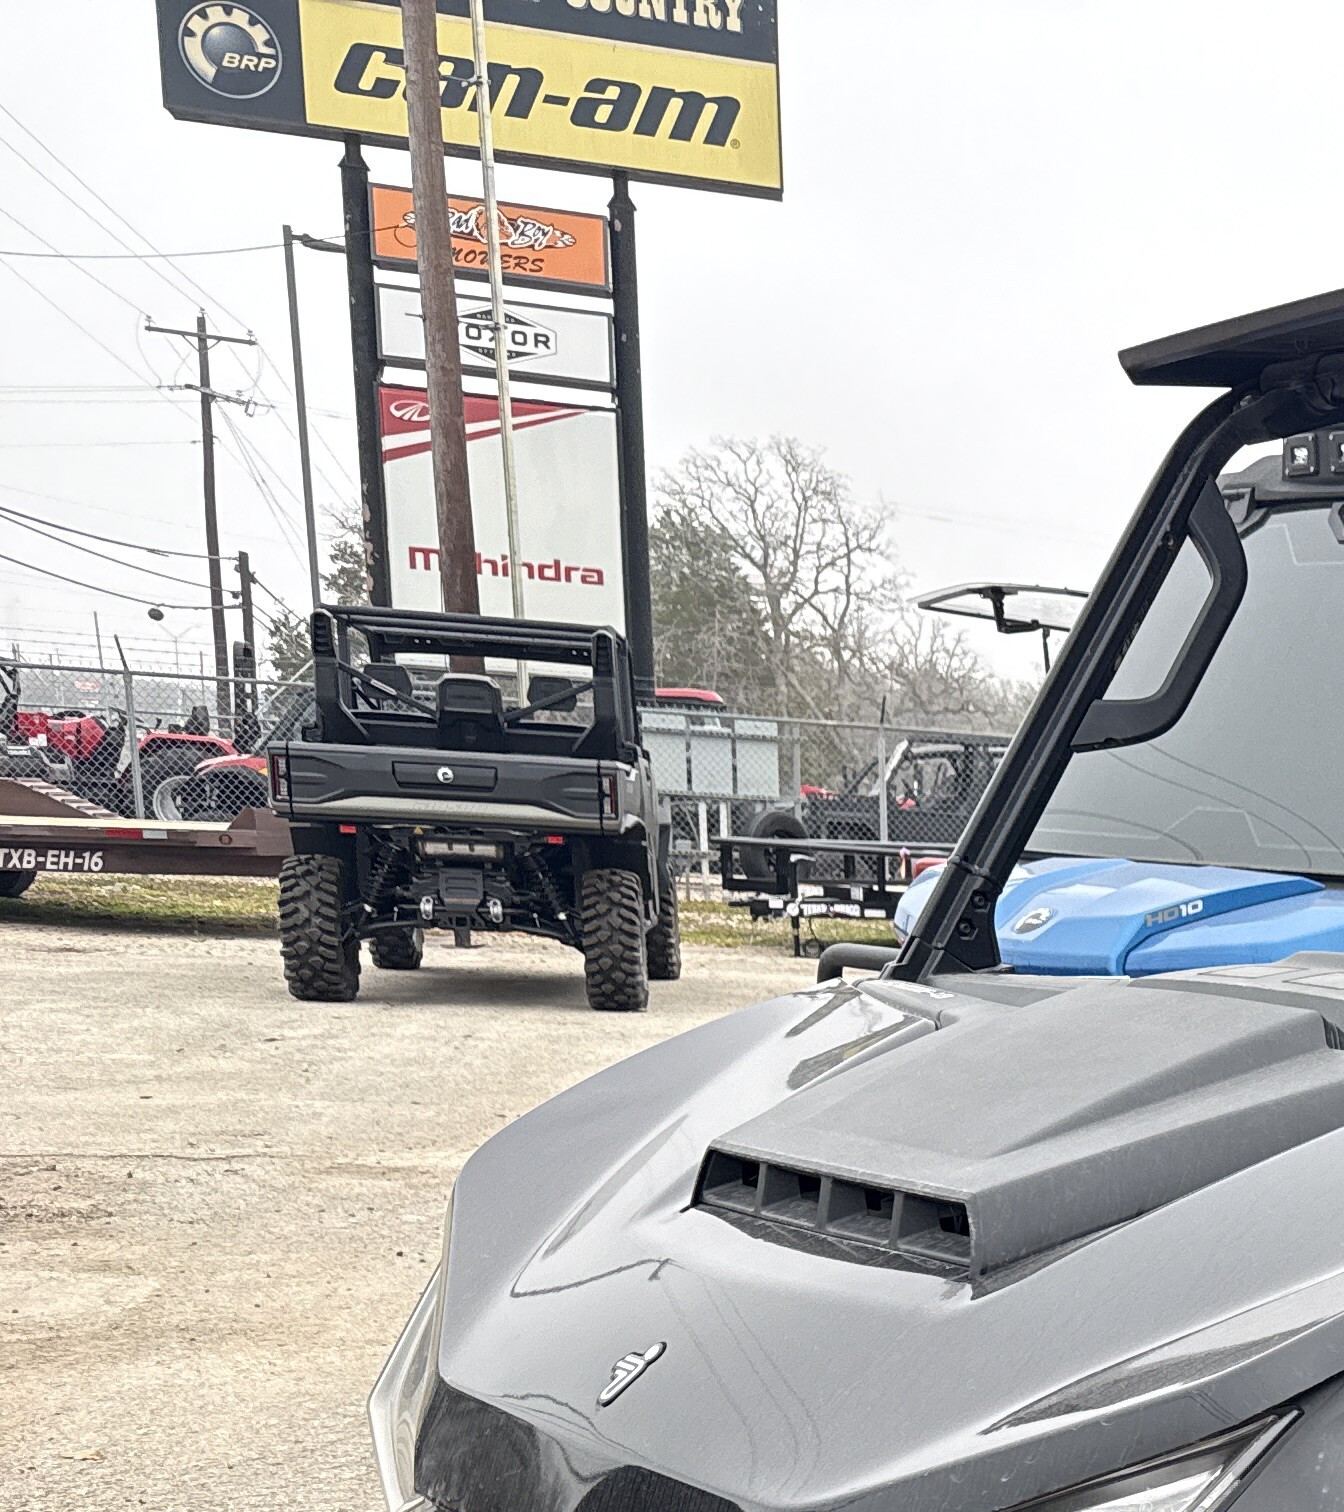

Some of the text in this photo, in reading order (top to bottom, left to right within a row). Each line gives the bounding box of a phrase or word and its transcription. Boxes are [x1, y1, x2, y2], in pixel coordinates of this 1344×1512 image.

[222, 52, 277, 73] BRP
[465, 323, 551, 350] OOR
[408, 546, 604, 586] mhindra
[1145, 899, 1204, 927] HD10
